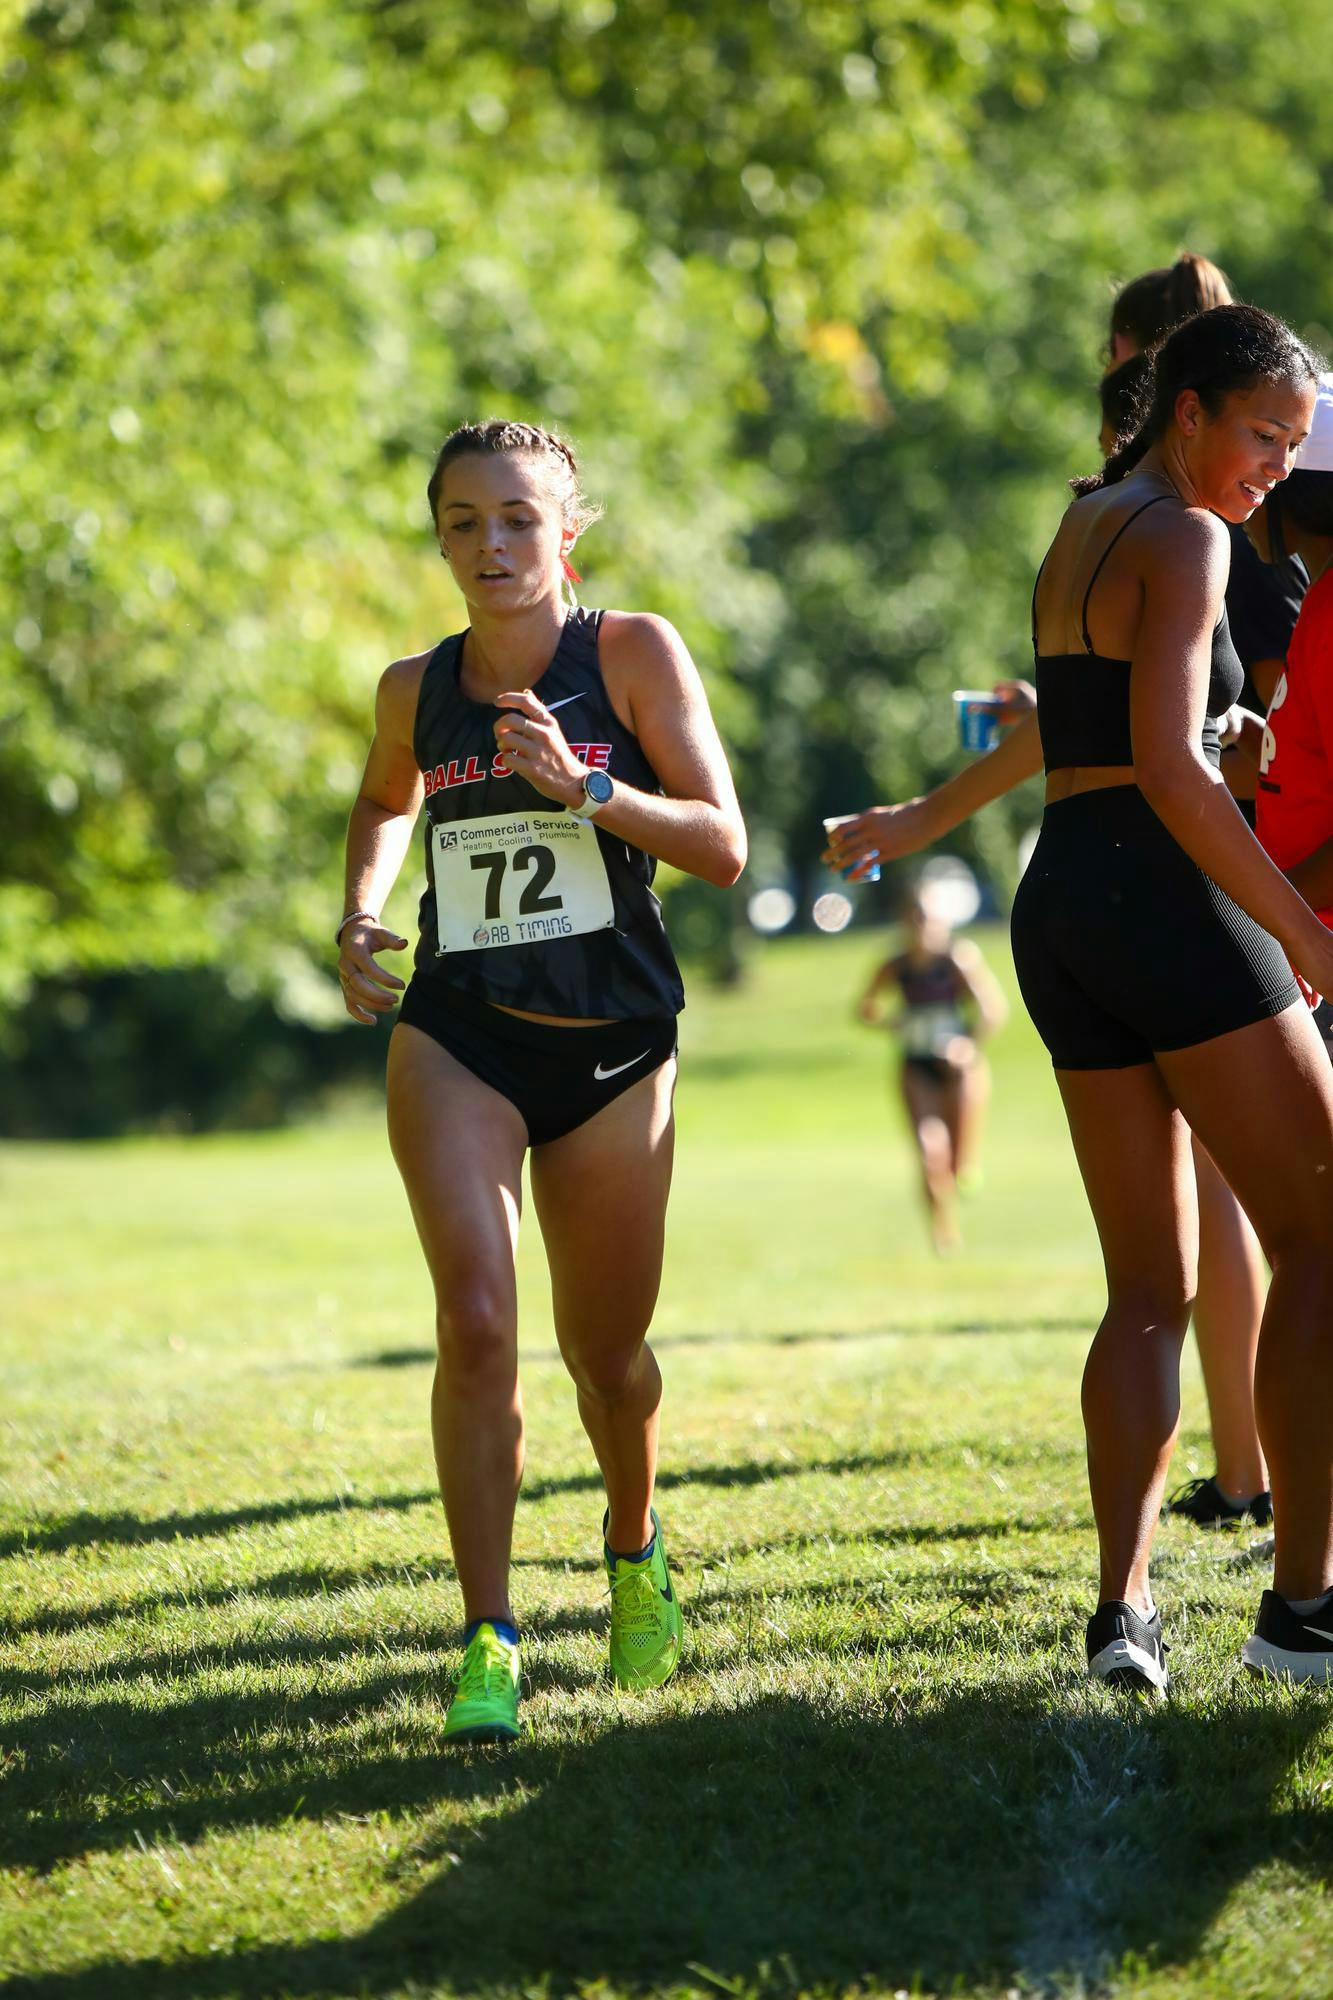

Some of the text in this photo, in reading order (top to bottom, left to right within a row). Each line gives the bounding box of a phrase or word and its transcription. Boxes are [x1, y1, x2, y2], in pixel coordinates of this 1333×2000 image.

[423, 756, 486, 799] BALL
[460, 820, 579, 840] Commercial Service
[463, 831, 580, 852] Heating Cooling Plumbing
[470, 845, 563, 920] 72
[491, 925, 510, 944] AB
[516, 915, 572, 940] TIMING
